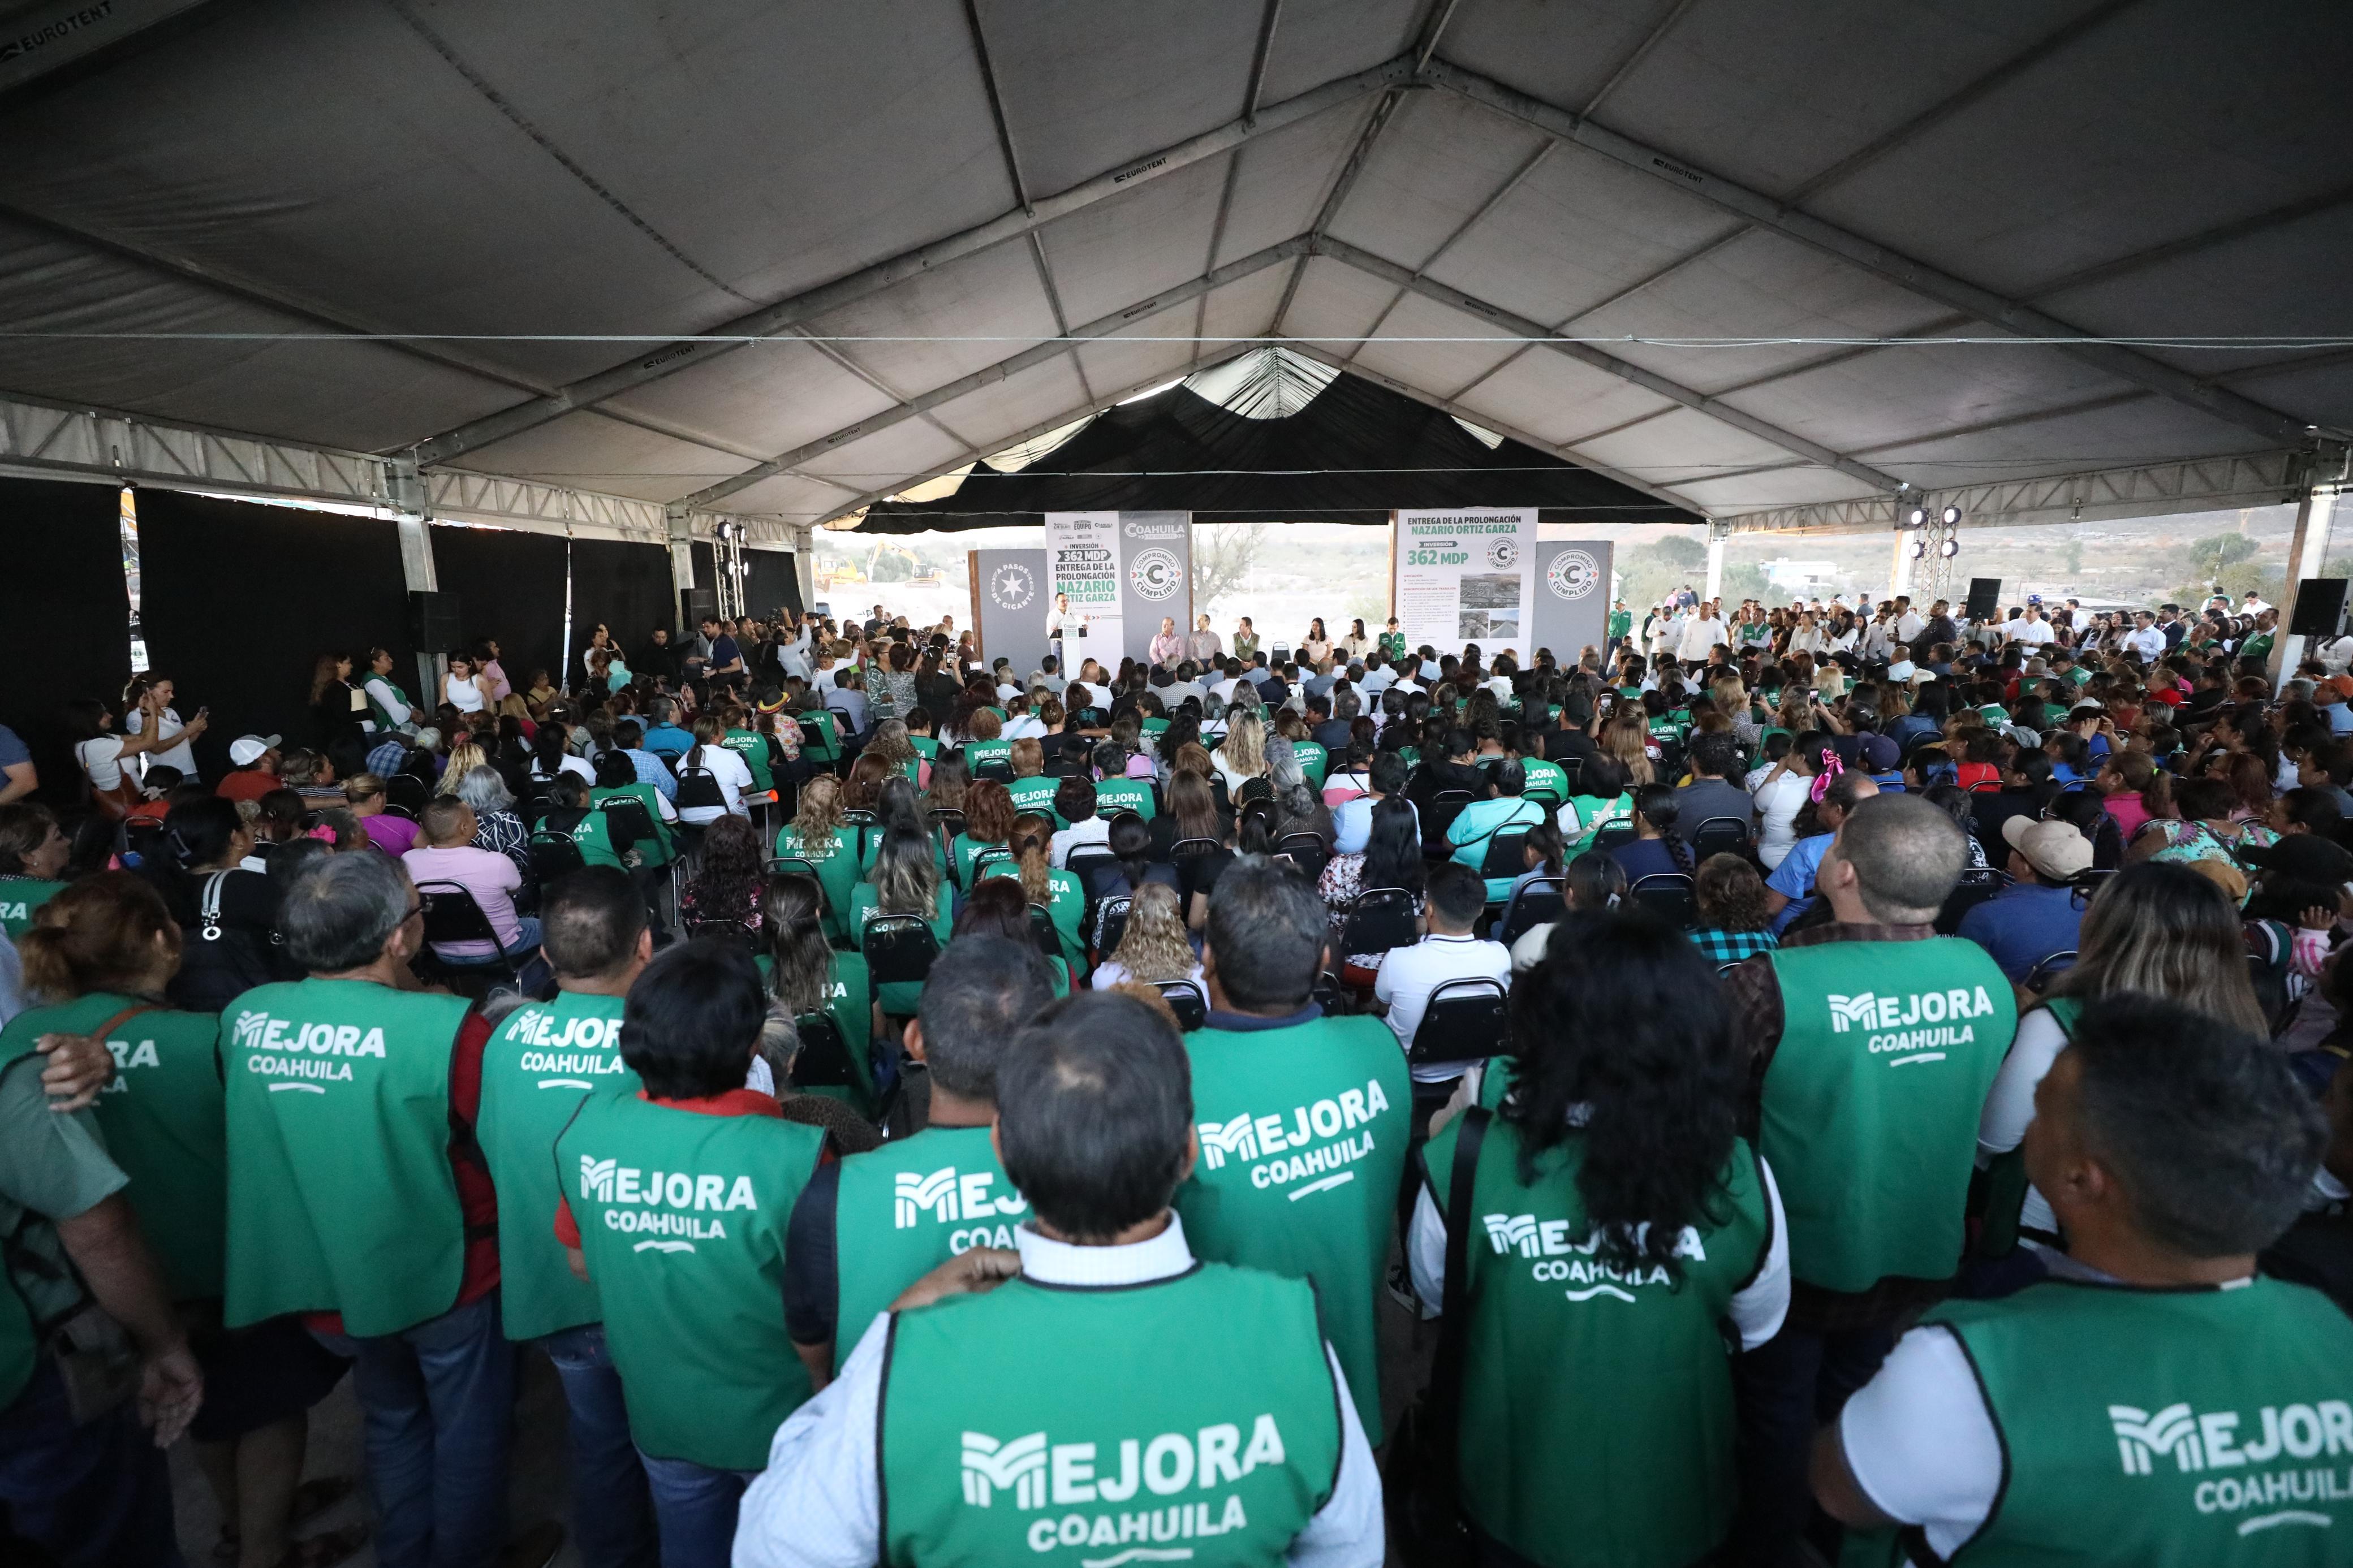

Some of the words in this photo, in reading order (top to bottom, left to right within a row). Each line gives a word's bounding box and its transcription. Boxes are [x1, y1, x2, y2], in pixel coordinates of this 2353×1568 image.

[21, 1, 114, 51] EUROTENT
[1126, 157, 1167, 179] EUROTENT
[1664, 162, 1704, 184] EUROTENT
[1131, 301, 1157, 316] EUROTENT
[1472, 304, 1497, 317] EUROTENT
[655, 345, 696, 365] EUROTENT
[835, 427, 860, 441] EUROTENT
[1464, 514, 1522, 524] PROLONGACIÓN
[1124, 523, 1185, 537] COAHUILA
[1411, 526, 1454, 535] NAZARIO
[1456, 525, 1484, 534] ORTIZ
[1485, 524, 1517, 534] GARZA
[1490, 539, 1515, 550] COMPROMISO
[1064, 551, 1083, 561] 362
[1084, 550, 1107, 561] MDP
[1136, 552, 1175, 569] COMPROMISO
[1408, 550, 1438, 565] 362
[1441, 552, 1469, 565] MDP
[1490, 557, 1515, 568] CUMPLIDO
[1554, 554, 1592, 569] COMPROMISO
[1003, 563, 1029, 574] PASOS
[1056, 571, 1115, 581] PROLONGACIÓN
[1057, 580, 1115, 593] NAZARIO
[1137, 580, 1176, 597] CUMPLIDO
[1553, 580, 1592, 595] CUMPLIDO
[992, 592, 1001, 604] DE
[1002, 591, 1035, 610] GIGANTE
[1066, 594, 1084, 603] RTIZ
[1085, 593, 1116, 602] GARZA
[721, 737, 759, 746] MEJORA
[1294, 748, 1322, 758] EJORA
[1010, 789, 1056, 804] MEJORA
[1097, 793, 1143, 805] MEJORA
[1828, 986, 1994, 1033] MEJORA
[232, 1010, 387, 1058] MEJORA
[505, 1010, 624, 1048] MEJOR
[1868, 1025, 1975, 1053] COAHUILA
[248, 1055, 353, 1081] COAHUILA
[520, 1051, 625, 1074] COAHUILA
[1197, 1079, 1389, 1170] MEJORA
[1251, 1130, 1375, 1189] COAHUILA
[581, 1155, 758, 1212] MEJORA
[895, 1166, 1028, 1229] MEJ
[604, 1209, 727, 1239] COAHUILA
[2109, 1400, 2353, 1475] MEJOR
[962, 1414, 1286, 1510] MEJORA
[1027, 1494, 1247, 1552] COAHUILA
